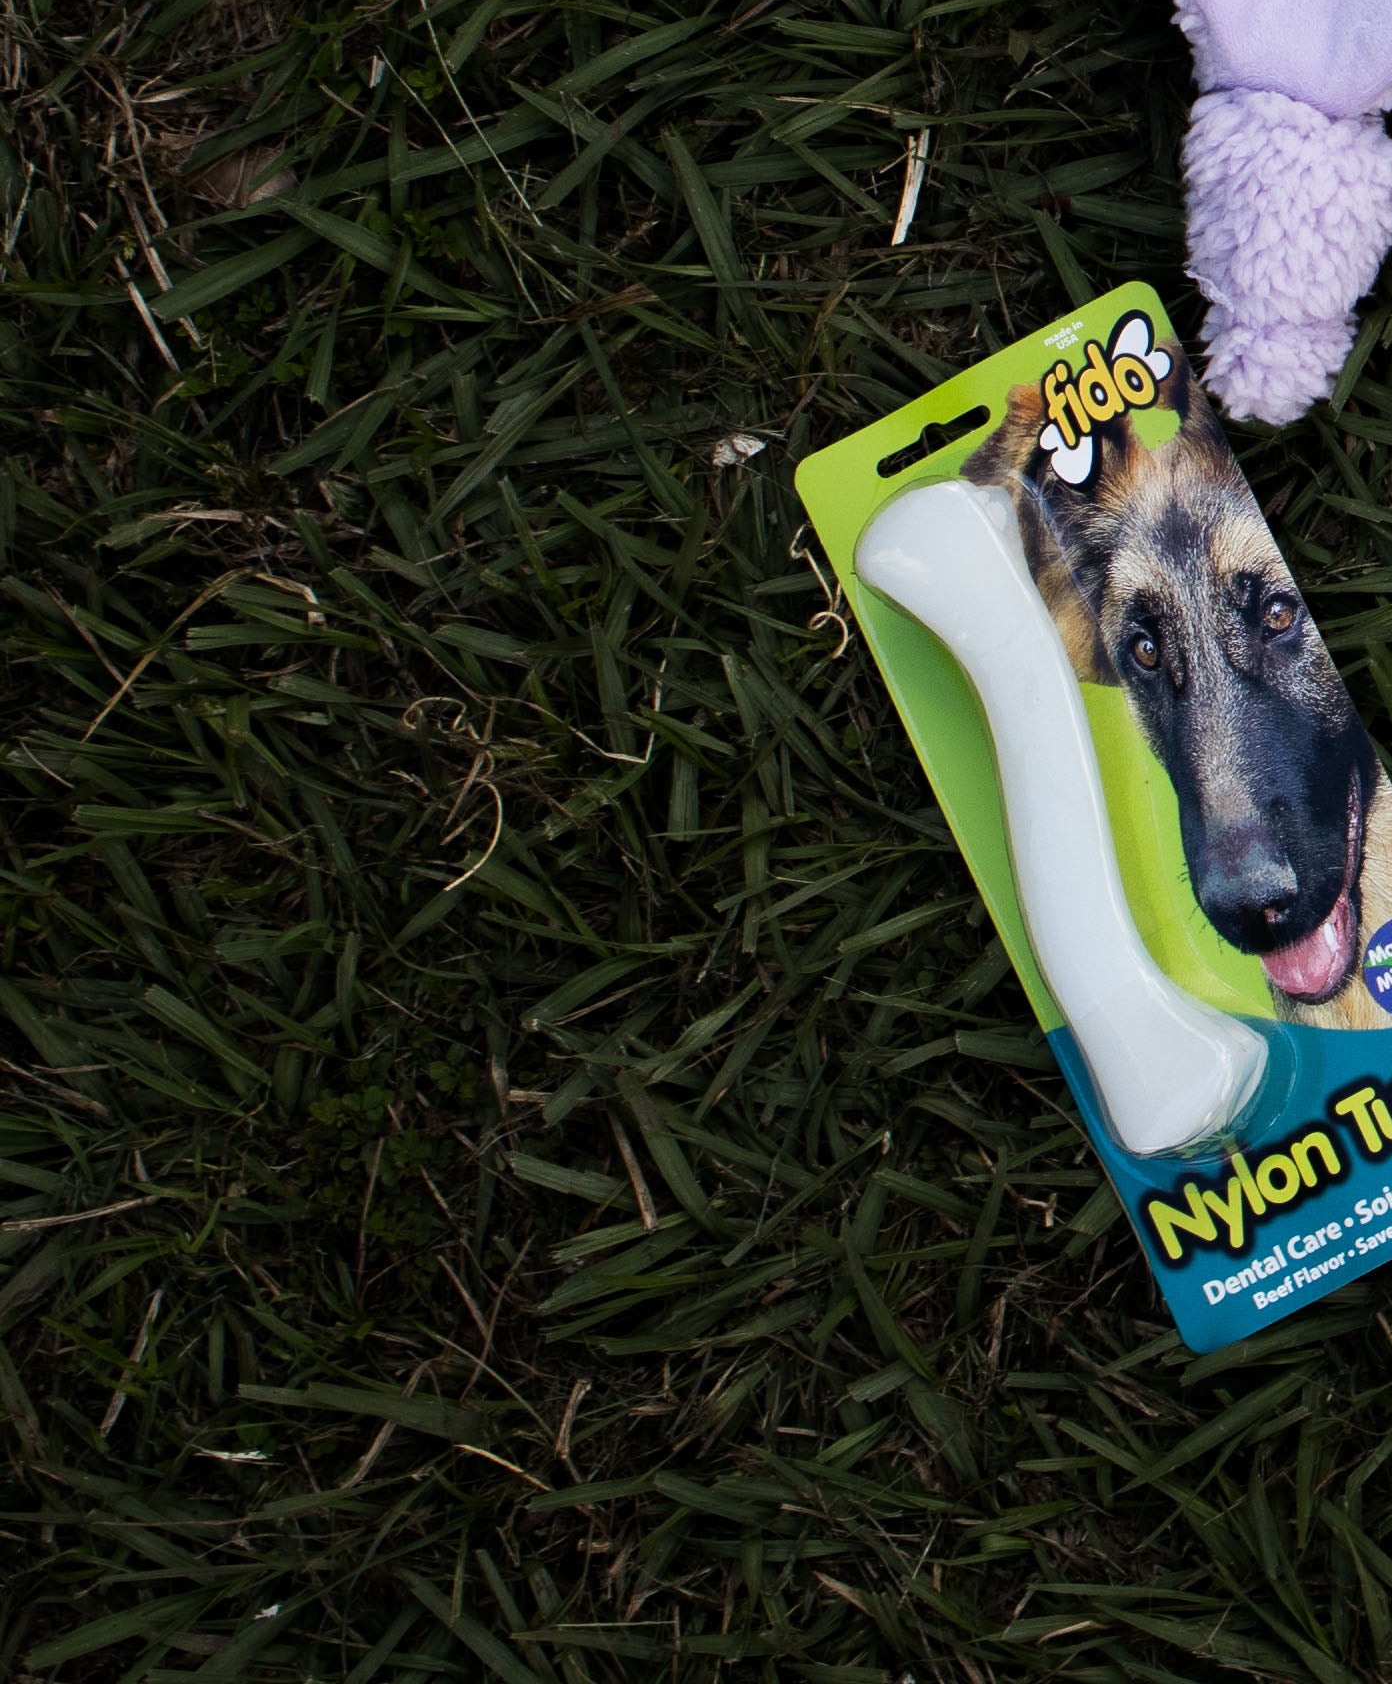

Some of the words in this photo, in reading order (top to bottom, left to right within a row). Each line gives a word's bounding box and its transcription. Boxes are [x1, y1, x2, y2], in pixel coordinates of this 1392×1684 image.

[1044, 327, 1072, 346] made
[1072, 320, 1084, 331] in
[1056, 334, 1079, 349] USA
[1044, 343, 1155, 447] fido
[1147, 1130, 1342, 1260] Nylon
[1202, 1244, 1287, 1305] Dental
[1286, 1221, 1342, 1259] Care
[1252, 1275, 1294, 1309] Beef
[1292, 1251, 1345, 1288] Flavor
